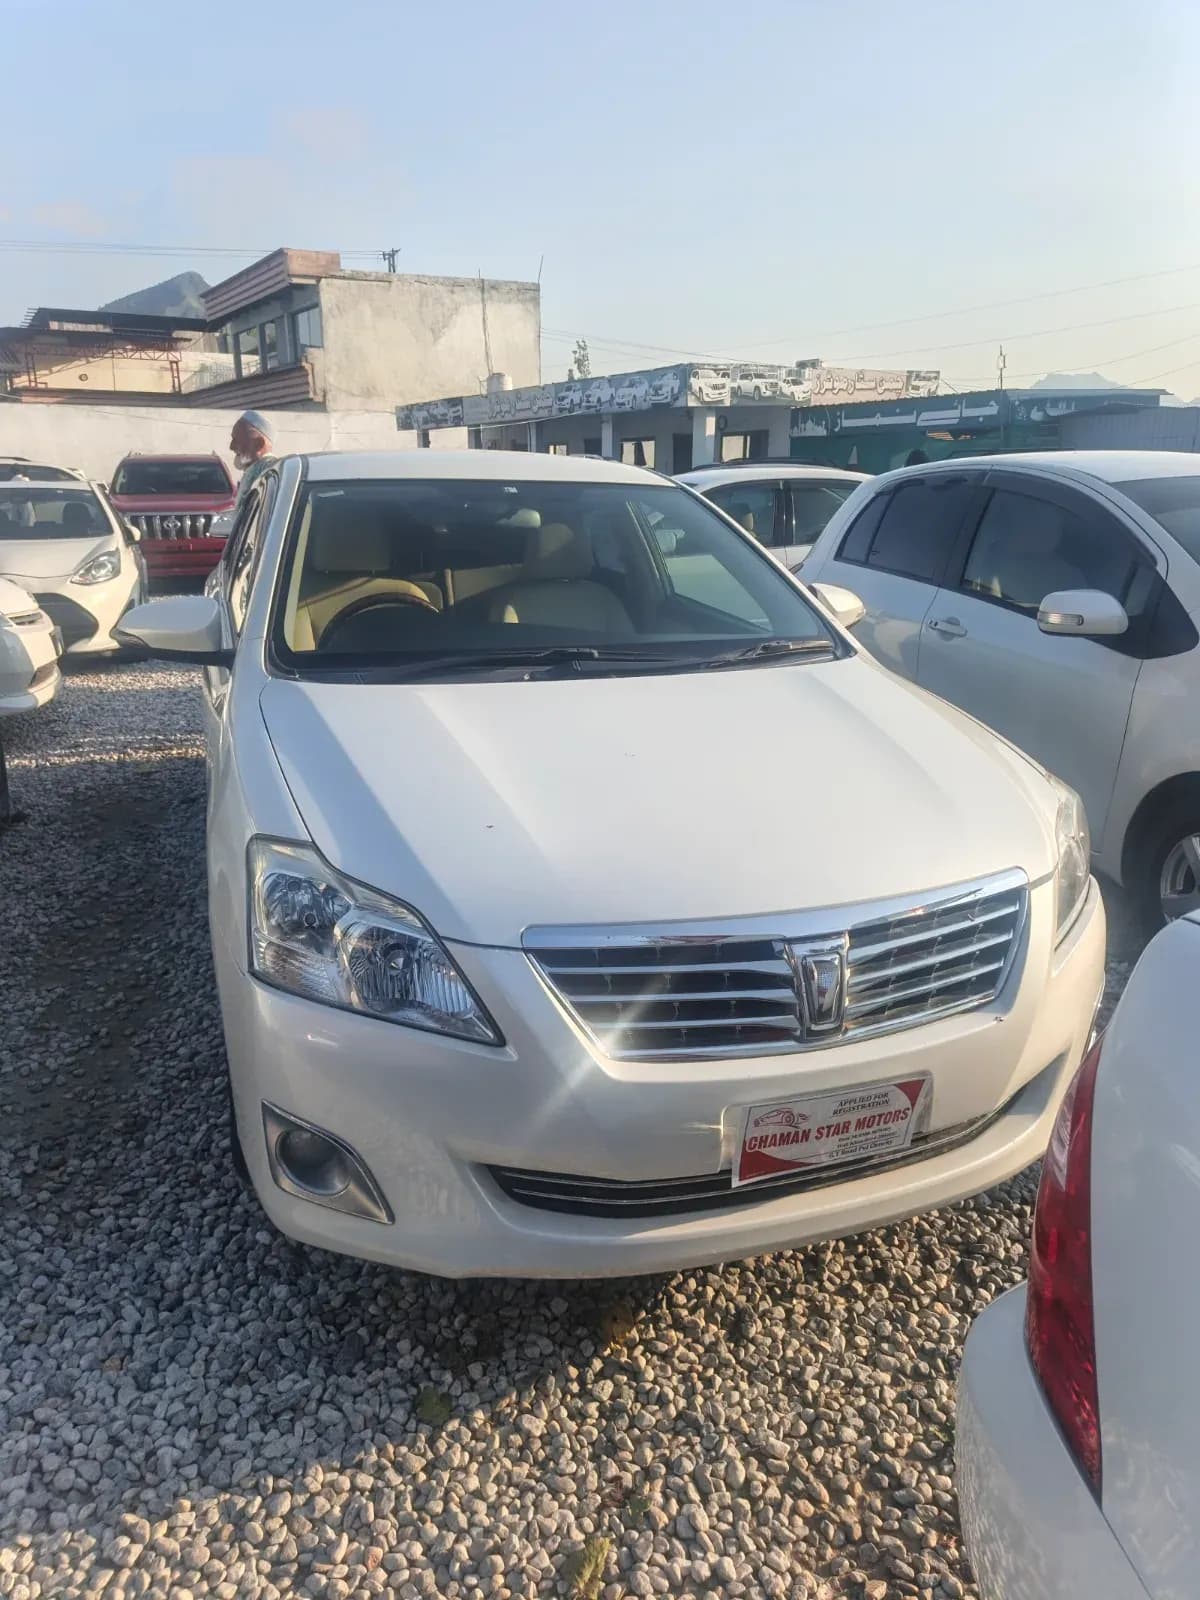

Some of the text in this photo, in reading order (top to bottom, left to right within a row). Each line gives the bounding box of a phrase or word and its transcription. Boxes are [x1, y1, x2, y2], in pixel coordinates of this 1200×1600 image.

[832, 1099, 890, 1116] REGISTRATION
[838, 1092, 889, 1107] APPLIED FOR
[747, 1129, 812, 1151] CHAMAN
[815, 1120, 851, 1140] STAR
[854, 1107, 911, 1131] MOTORS
